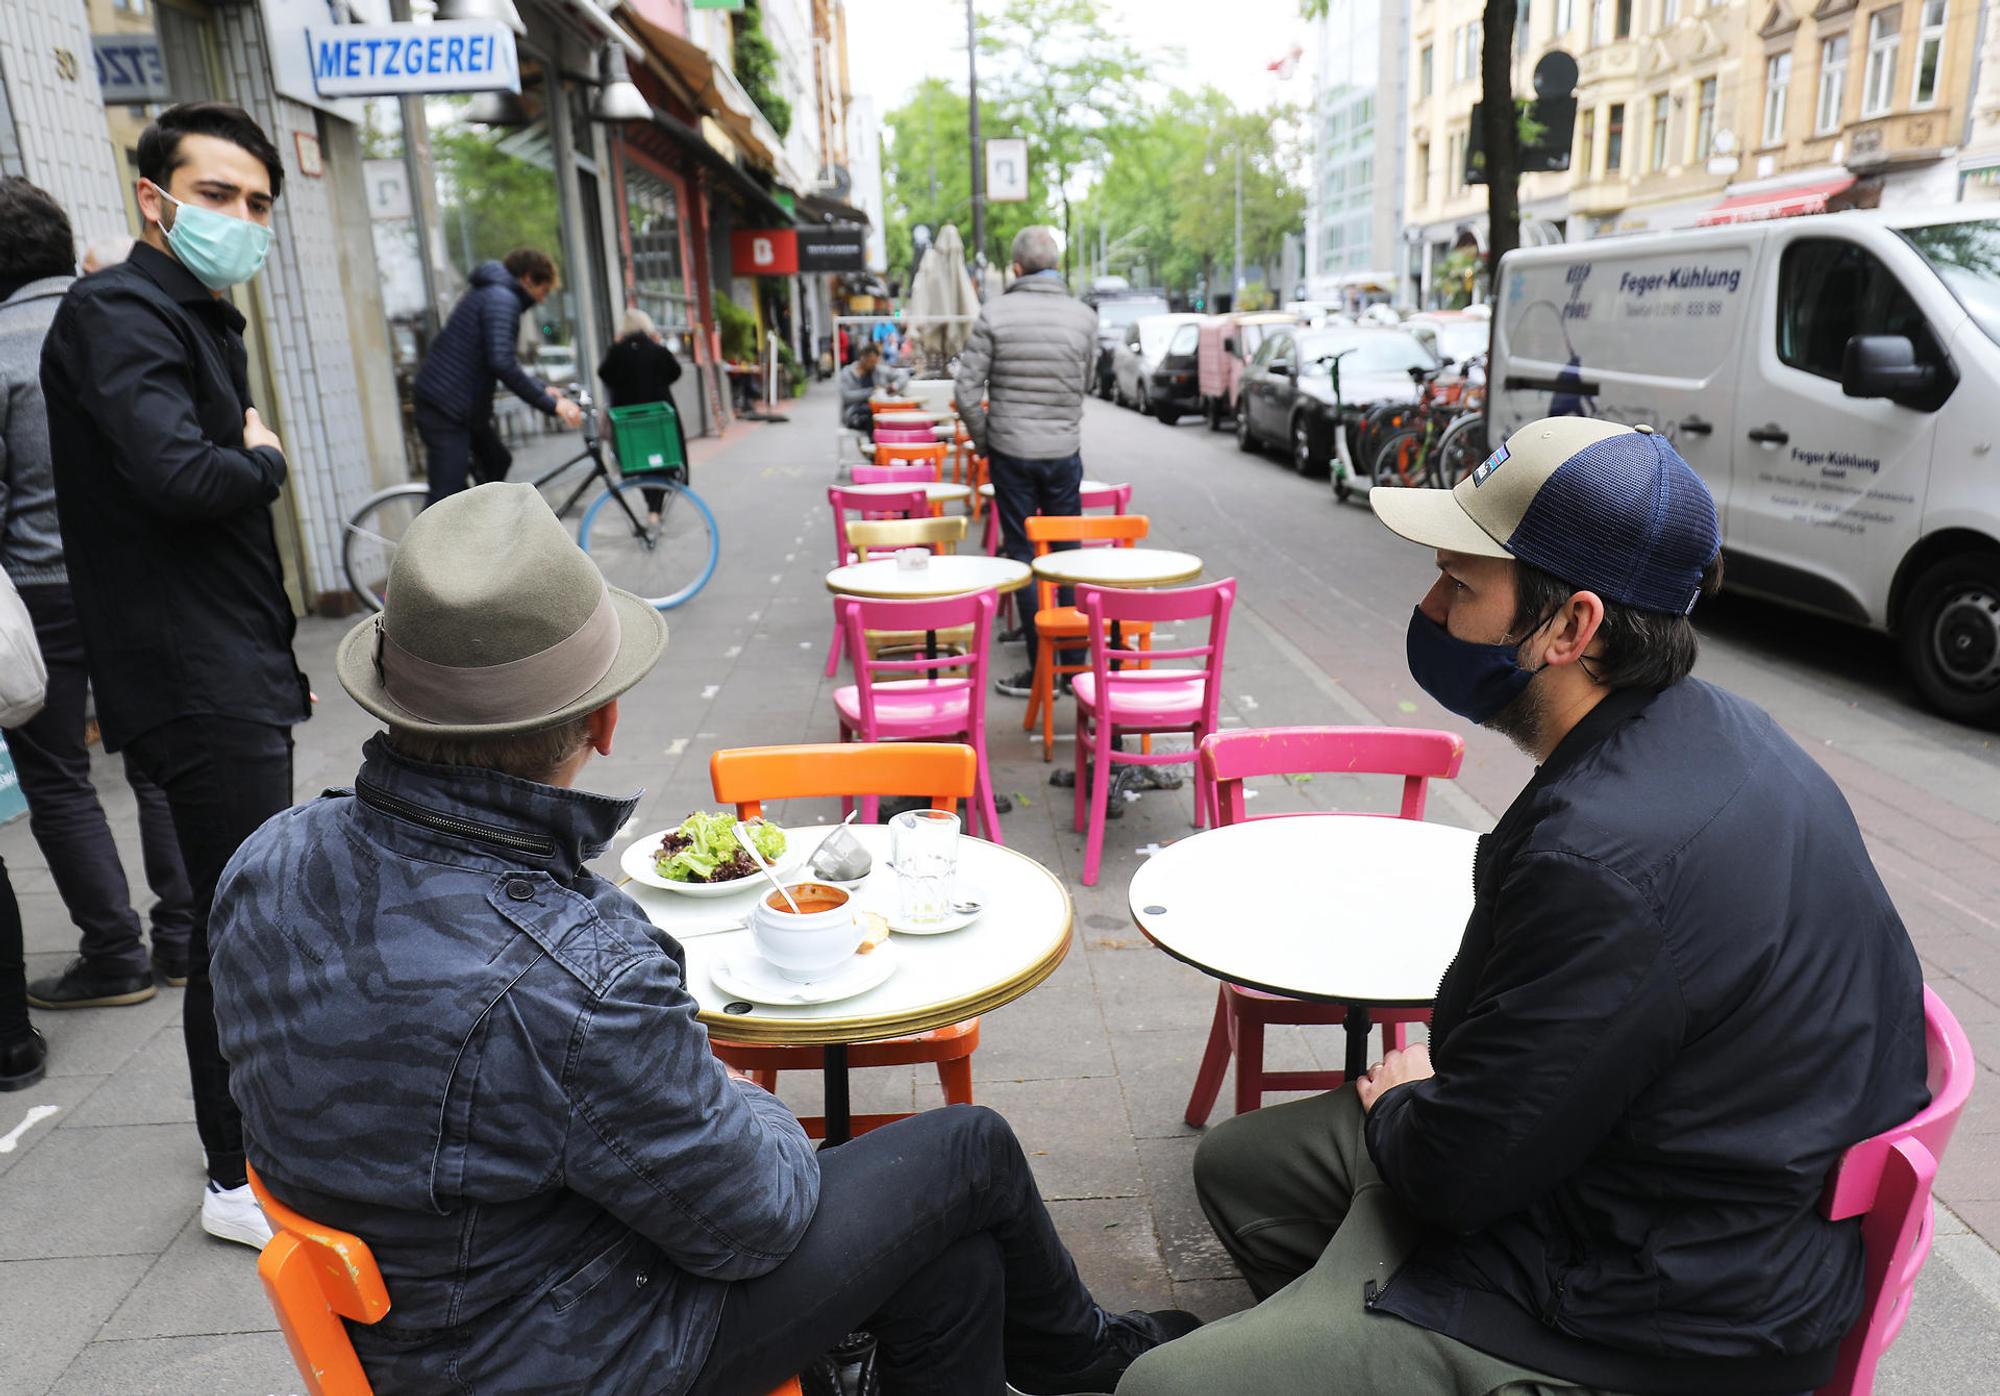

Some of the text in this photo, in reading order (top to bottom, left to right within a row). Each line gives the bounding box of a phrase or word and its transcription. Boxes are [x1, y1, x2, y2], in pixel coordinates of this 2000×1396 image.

[319, 35, 494, 78] METZGEREI
[1619, 265, 1742, 296] Feger-Kühlung
[1791, 447, 1880, 473] Feger-Kühlung
